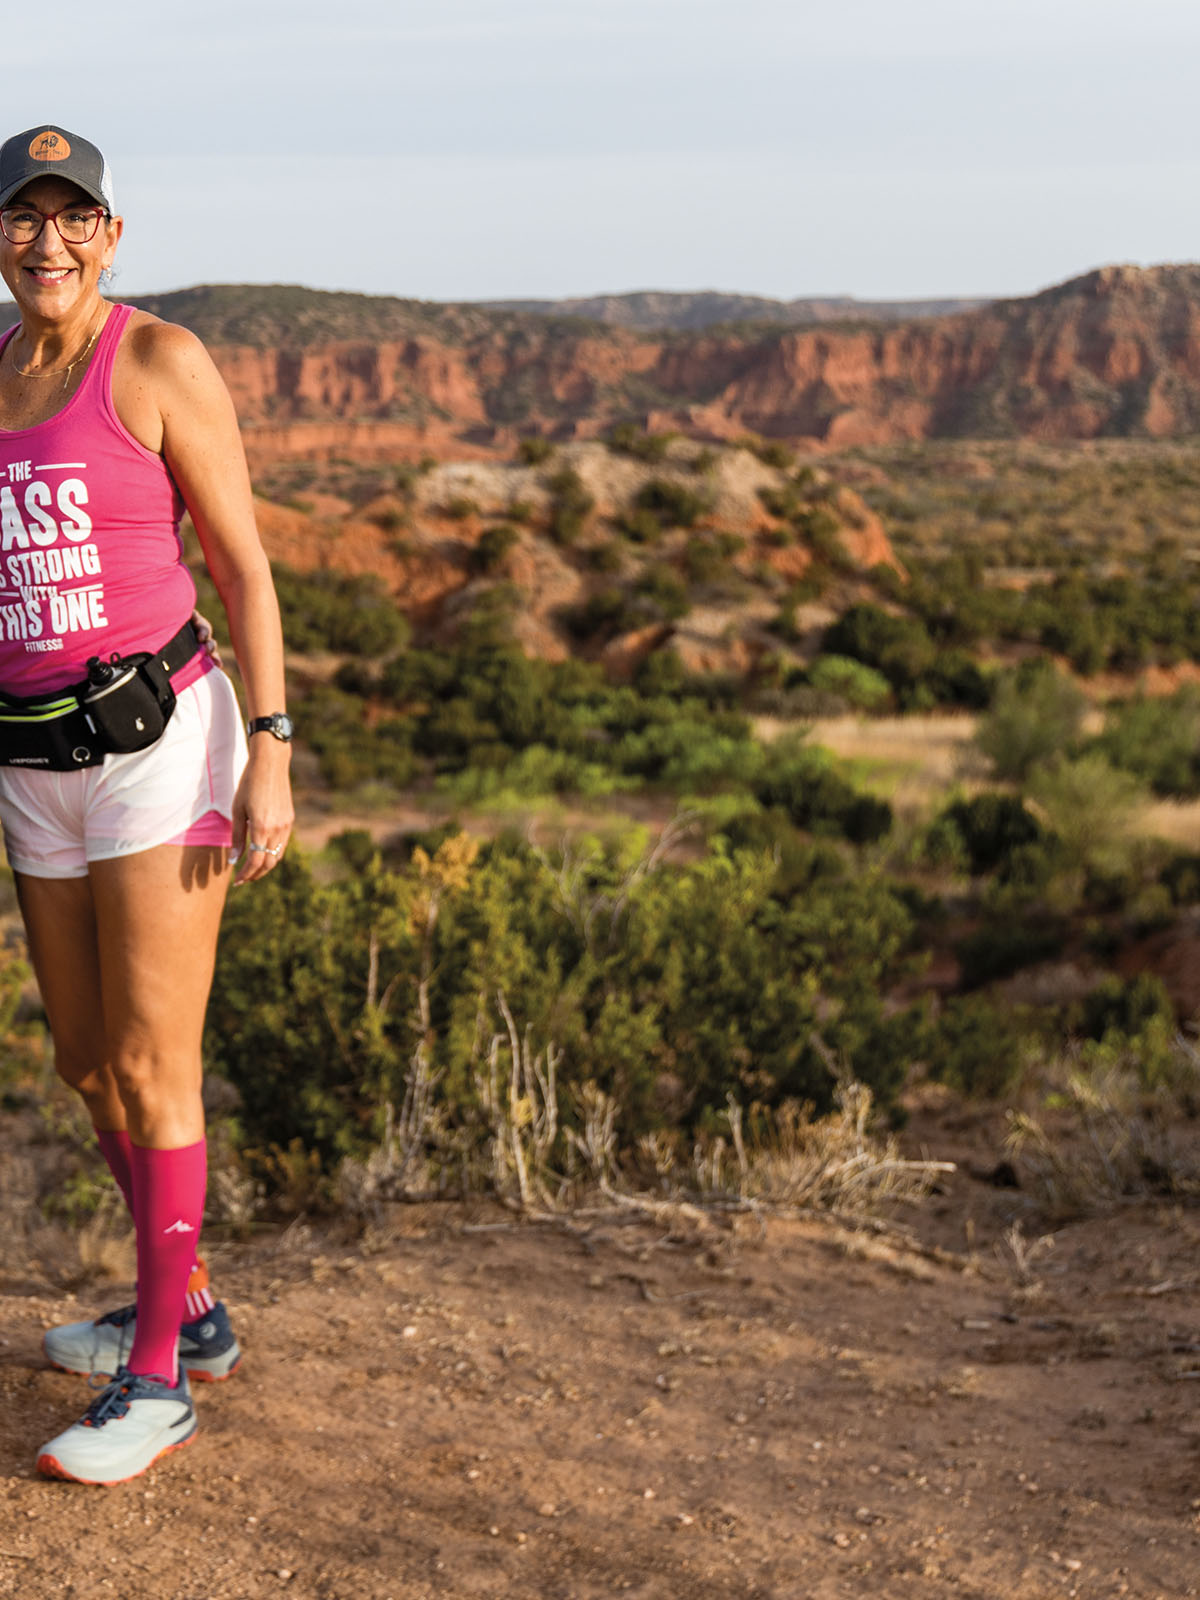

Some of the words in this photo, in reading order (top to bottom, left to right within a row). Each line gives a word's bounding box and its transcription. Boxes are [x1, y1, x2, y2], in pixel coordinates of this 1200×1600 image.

[7, 460, 32, 482] THE
[9, 544, 102, 587] STRONG
[20, 586, 57, 602] WITH
[49, 591, 109, 634] ONE
